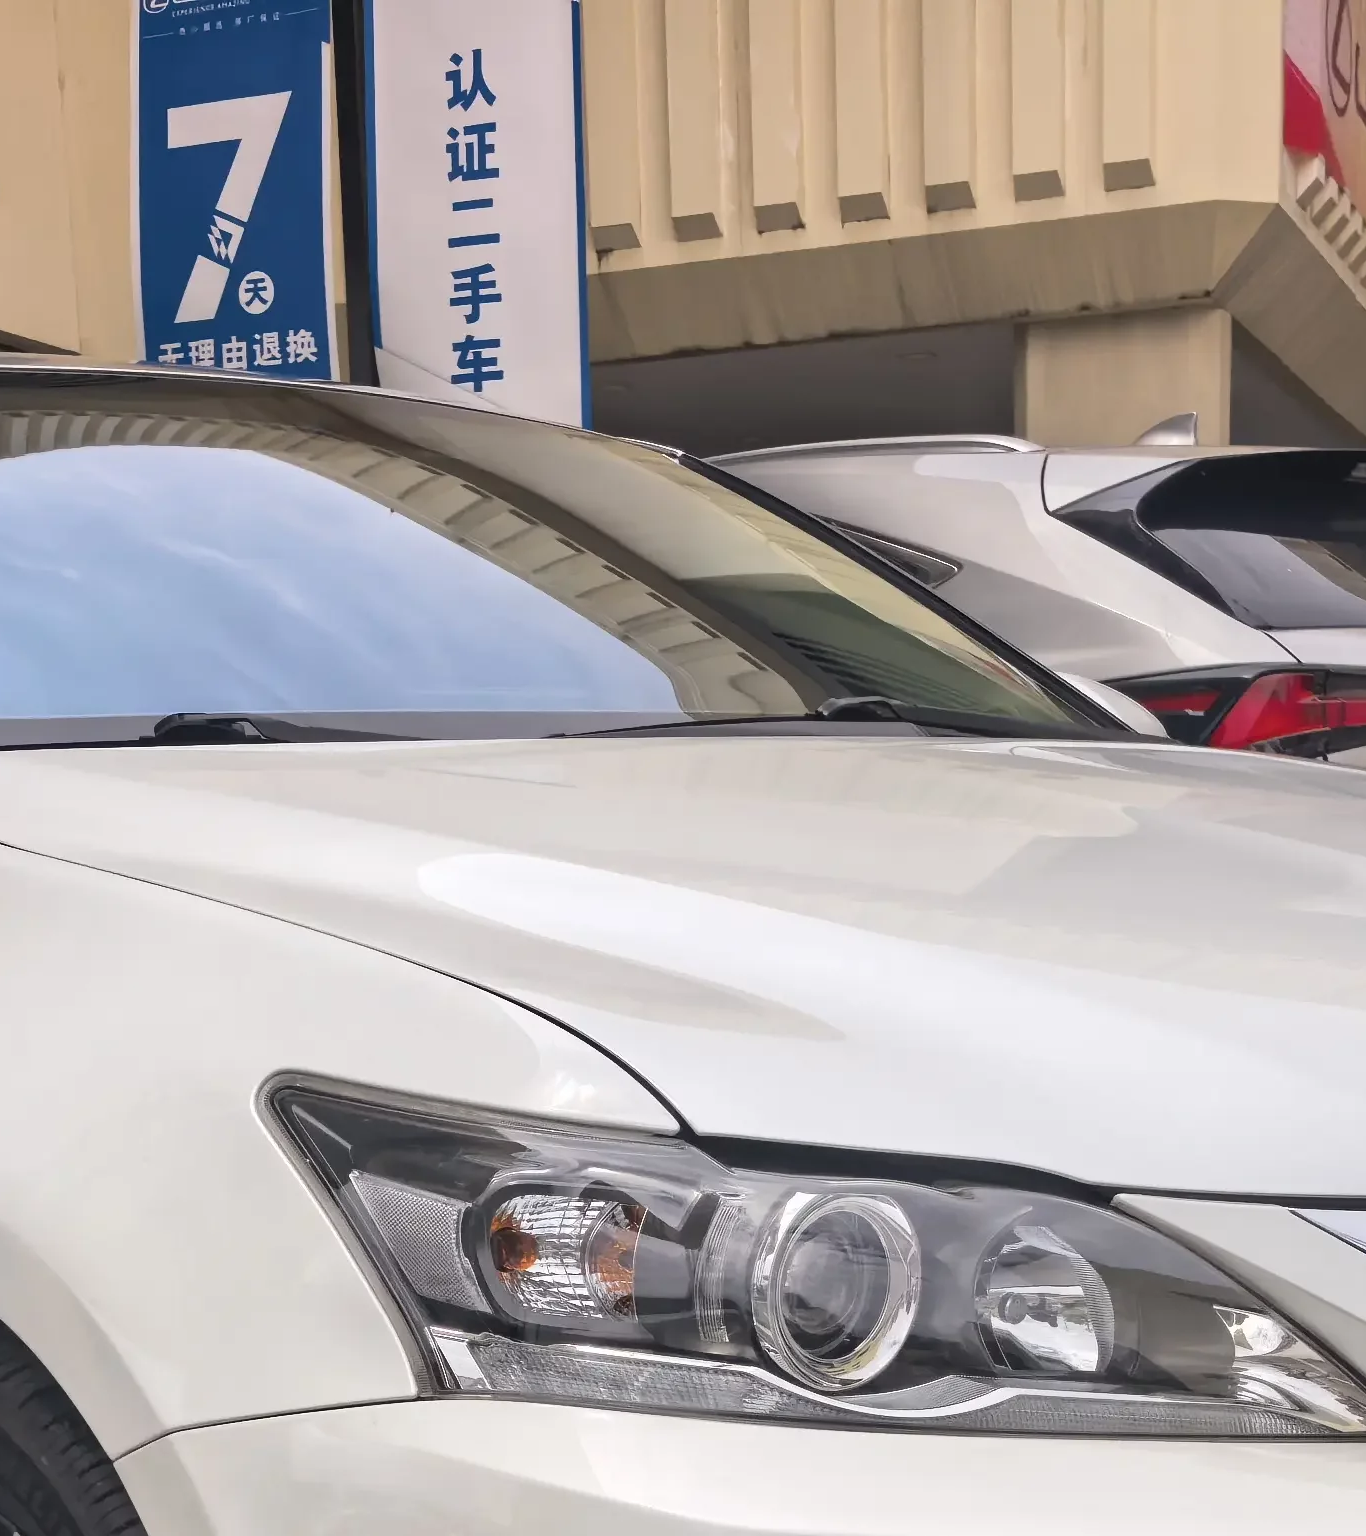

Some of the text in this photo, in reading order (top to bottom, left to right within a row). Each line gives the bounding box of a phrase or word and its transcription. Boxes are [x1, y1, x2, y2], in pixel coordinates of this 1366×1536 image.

[167, 90, 293, 325] 7
[444, 48, 505, 393] 认证二手车
[158, 328, 318, 371] 无理由退换
[243, 277, 270, 309] 天
